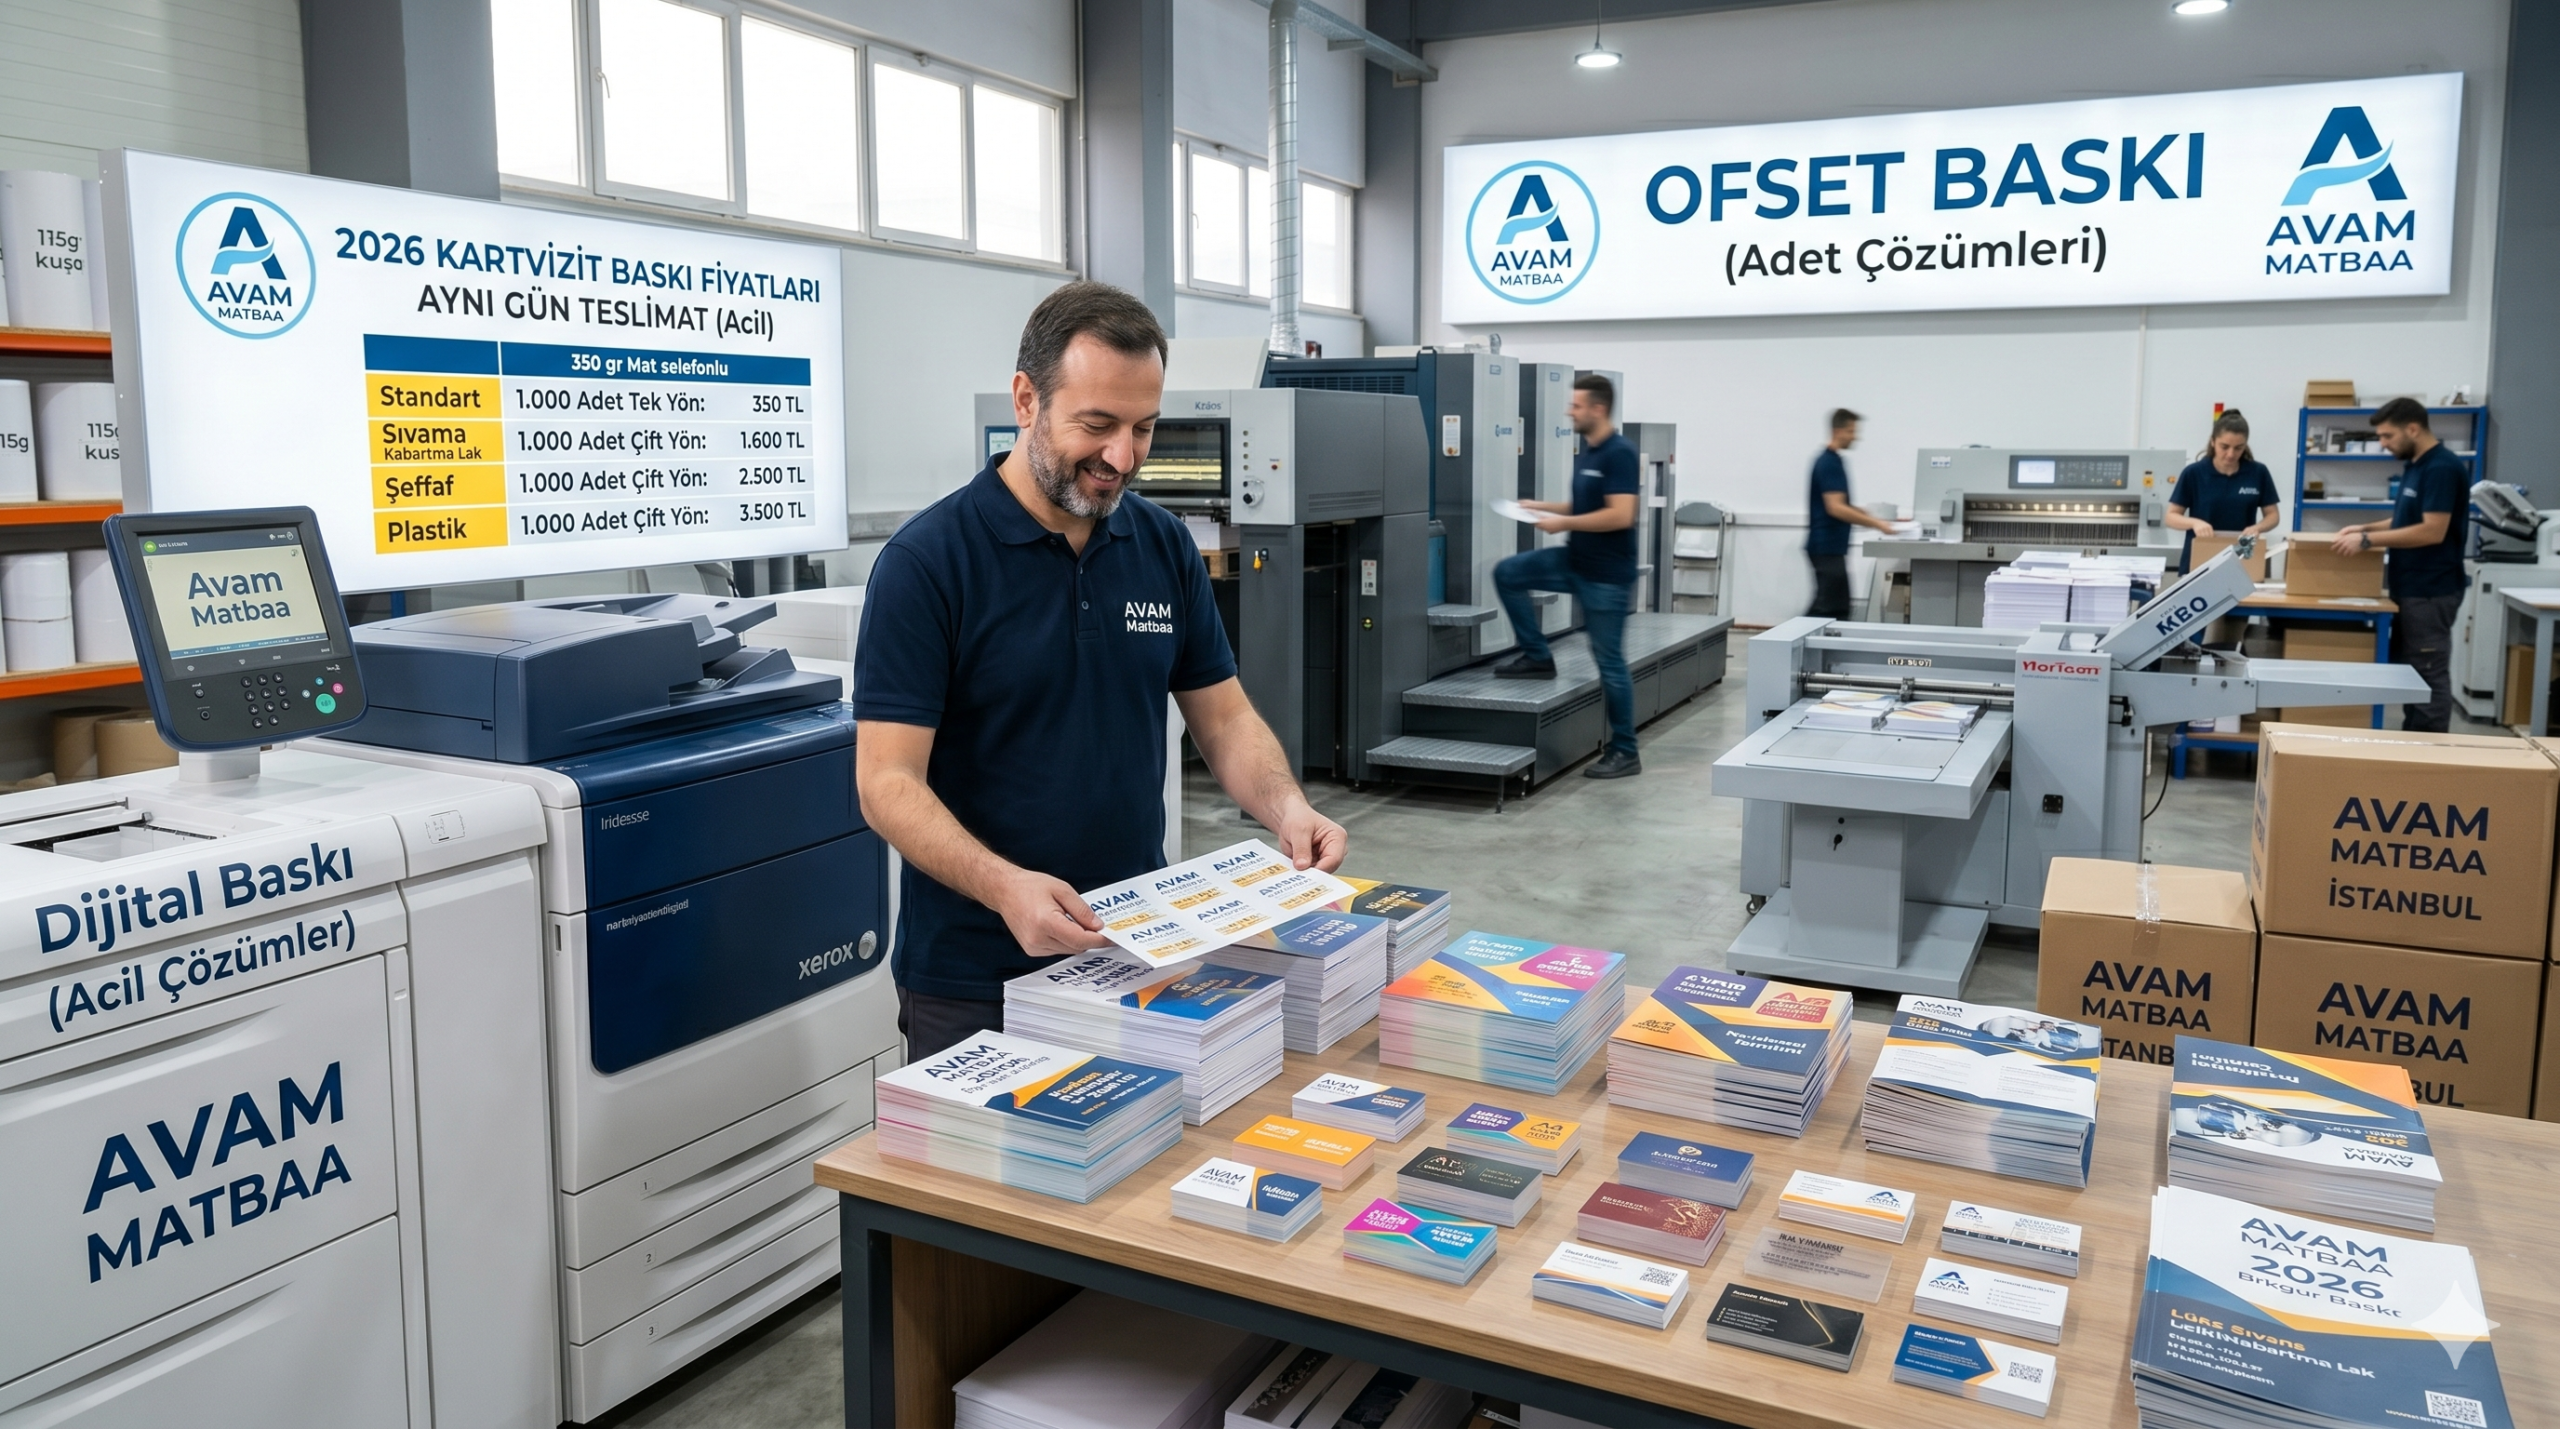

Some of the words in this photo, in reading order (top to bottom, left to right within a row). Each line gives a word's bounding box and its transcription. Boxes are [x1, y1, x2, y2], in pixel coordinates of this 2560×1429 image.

[1646, 151, 1905, 225] OFSET
[1934, 132, 2205, 211] BASKI
[2266, 210, 2415, 247] AVAM
[334, 227, 425, 266] 2026
[436, 238, 602, 282] KARTVİZİT
[611, 257, 692, 291] BASKI
[701, 261, 820, 303] FİYATLARI
[1491, 248, 1572, 272] AVAM
[1725, 241, 1842, 285] (Adet
[1856, 225, 2107, 283] Çözümleri)
[2265, 250, 2414, 275] MATBAA
[207, 281, 292, 307] AVAM
[1499, 273, 1564, 286] MATBAA
[218, 306, 284, 322] MATBAA
[417, 284, 493, 317] AYNI
[504, 285, 570, 322] GÜN
[579, 295, 709, 331] TESLİMAT
[716, 307, 774, 342] (Acil)
[571, 353, 601, 372] 350
[605, 356, 623, 376] gr
[627, 356, 657, 374] Mat
[661, 358, 729, 376] selefonlu
[380, 385, 481, 408] Standart
[516, 389, 571, 410] 1.000
[577, 390, 624, 410] Adet
[629, 392, 662, 411] Tek
[666, 392, 705, 412] Yön:
[752, 395, 781, 413] 350
[785, 396, 804, 413] TL
[382, 423, 467, 444] Sıvama
[518, 431, 572, 451] 1.000
[578, 430, 625, 450] Adet
[631, 430, 663, 455] Çift
[668, 431, 706, 449] Yön:
[740, 431, 782, 449] 1.600
[786, 432, 805, 449] TL
[384, 448, 454, 460] Kabartma
[458, 447, 482, 460] Lak
[385, 475, 455, 504] Şeffaf
[520, 472, 574, 493] 1.000
[580, 471, 627, 491] Adet
[632, 469, 664, 494] Çift
[669, 468, 708, 487] Yön:
[739, 467, 783, 485] 2.500
[787, 467, 806, 483] TL
[388, 517, 467, 543] Plastik
[521, 513, 575, 535] 1.000
[581, 511, 628, 531] Adet
[634, 508, 666, 533] Çift
[671, 507, 709, 525] Yön:
[740, 502, 784, 522] 3.500
[788, 502, 806, 518] TL
[188, 571, 283, 600] Avam
[190, 600, 291, 628] Matbaa
[1125, 602, 1171, 619] AVAM
[2333, 797, 2490, 841] AVAM
[2330, 838, 2488, 876] MATBAA
[1154, 871, 1200, 891] AVAM
[35, 870, 204, 954] Dijital
[218, 842, 355, 909] Baskı
[2329, 877, 2482, 921] İSTANBUL
[48, 964, 145, 1033] (Acil
[158, 909, 356, 1003] Çözümler)
[798, 941, 854, 980] xerox
[2083, 960, 2212, 1002] AVAM
[2081, 996, 2212, 1033] MATBAA
[2317, 982, 2471, 1031] AVAM
[2315, 1020, 2469, 1064] MATBAA
[924, 1044, 997, 1079] AVAM
[942, 1050, 1013, 1082] MATBAA
[82, 1060, 345, 1215] AVAM
[644, 1181, 648, 1191] 1
[86, 1143, 352, 1284] MATBAA
[2241, 1217, 2388, 1263] AVAM
[2241, 1231, 2394, 1277] MATBAA
[646, 1253, 652, 1263] 2
[1928, 1279, 1970, 1292] AVAM
[2250, 1255, 2384, 1300] 2026
[648, 1326, 654, 1336] 3
